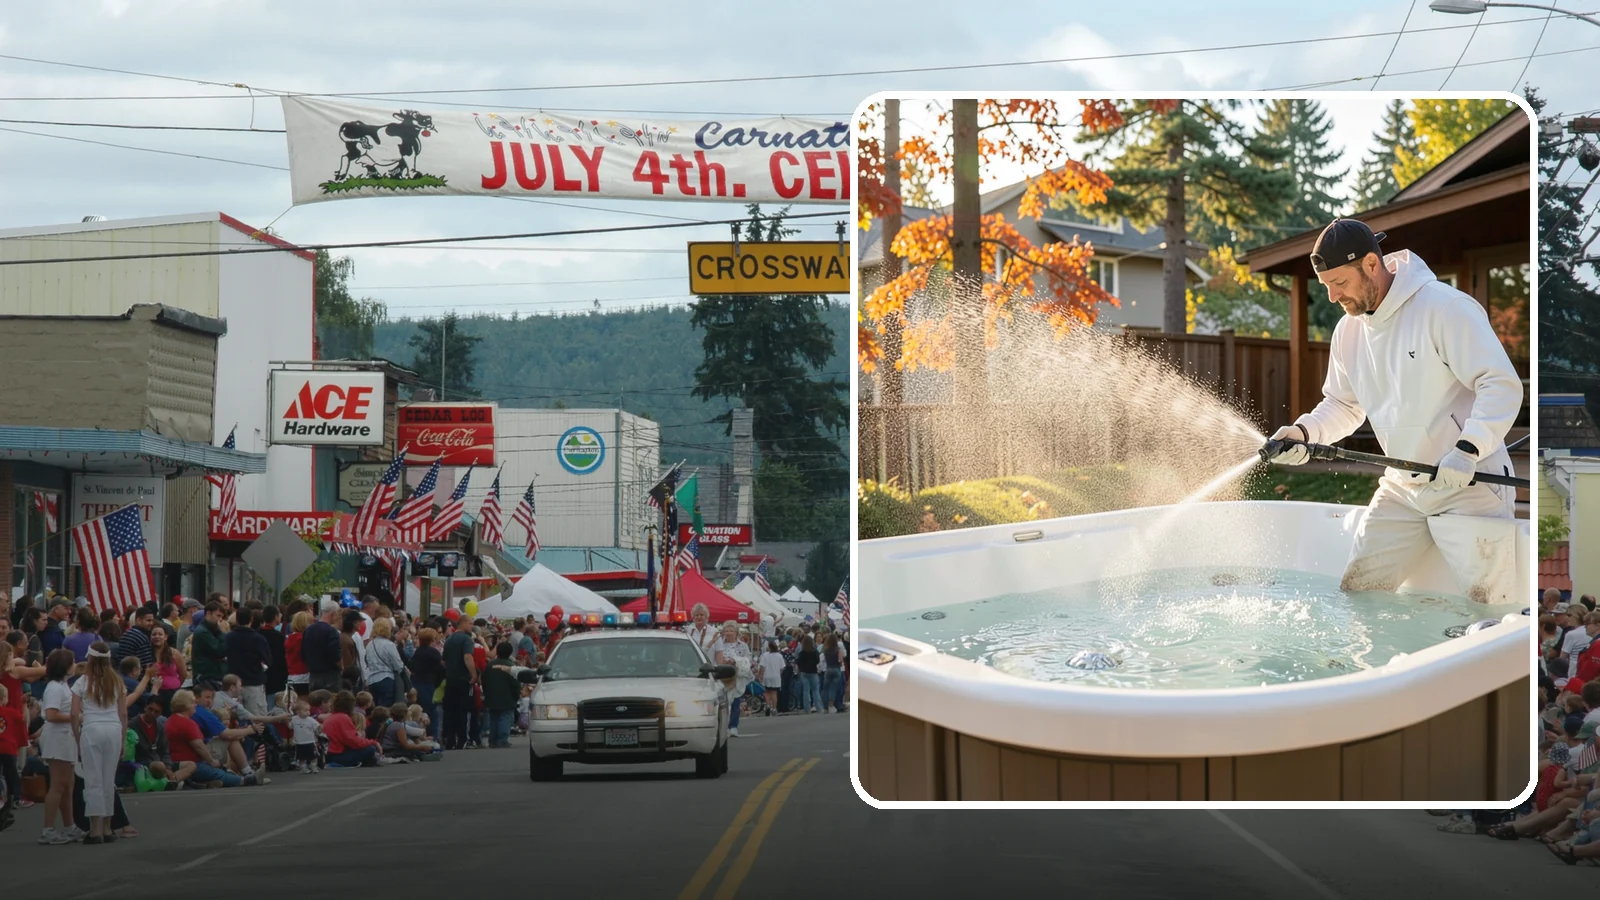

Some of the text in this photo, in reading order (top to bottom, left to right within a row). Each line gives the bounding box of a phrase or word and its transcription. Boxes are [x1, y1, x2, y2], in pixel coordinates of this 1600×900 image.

[481, 141, 604, 193] JULY
[632, 150, 747, 198] 4th.
[697, 253, 850, 280] CROSSWA
[282, 380, 373, 420] ACE
[405, 409, 485, 422] CEDAR LOG
[283, 421, 371, 436] Hardware
[353, 467, 386, 481] Simpl
[83, 484, 155, 495] St. Vincent de Paul
[688, 526, 741, 535] CRNATION
[699, 535, 730, 543] GLASS
